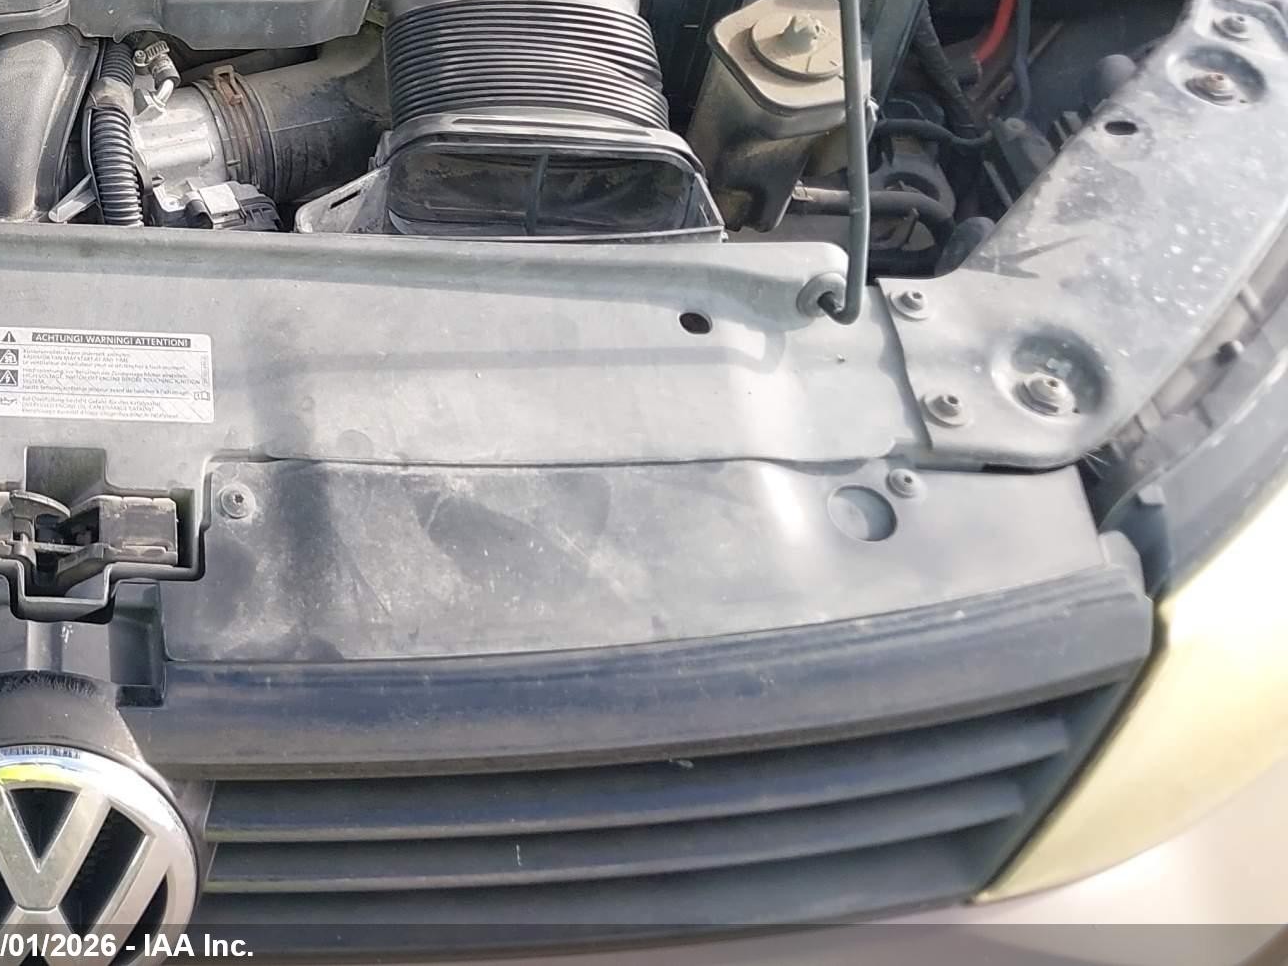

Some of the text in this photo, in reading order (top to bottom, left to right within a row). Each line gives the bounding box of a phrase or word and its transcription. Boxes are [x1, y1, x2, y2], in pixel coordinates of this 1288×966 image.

[35, 333, 189, 347] ACHTUNG! WARNING! ATTENTION!
